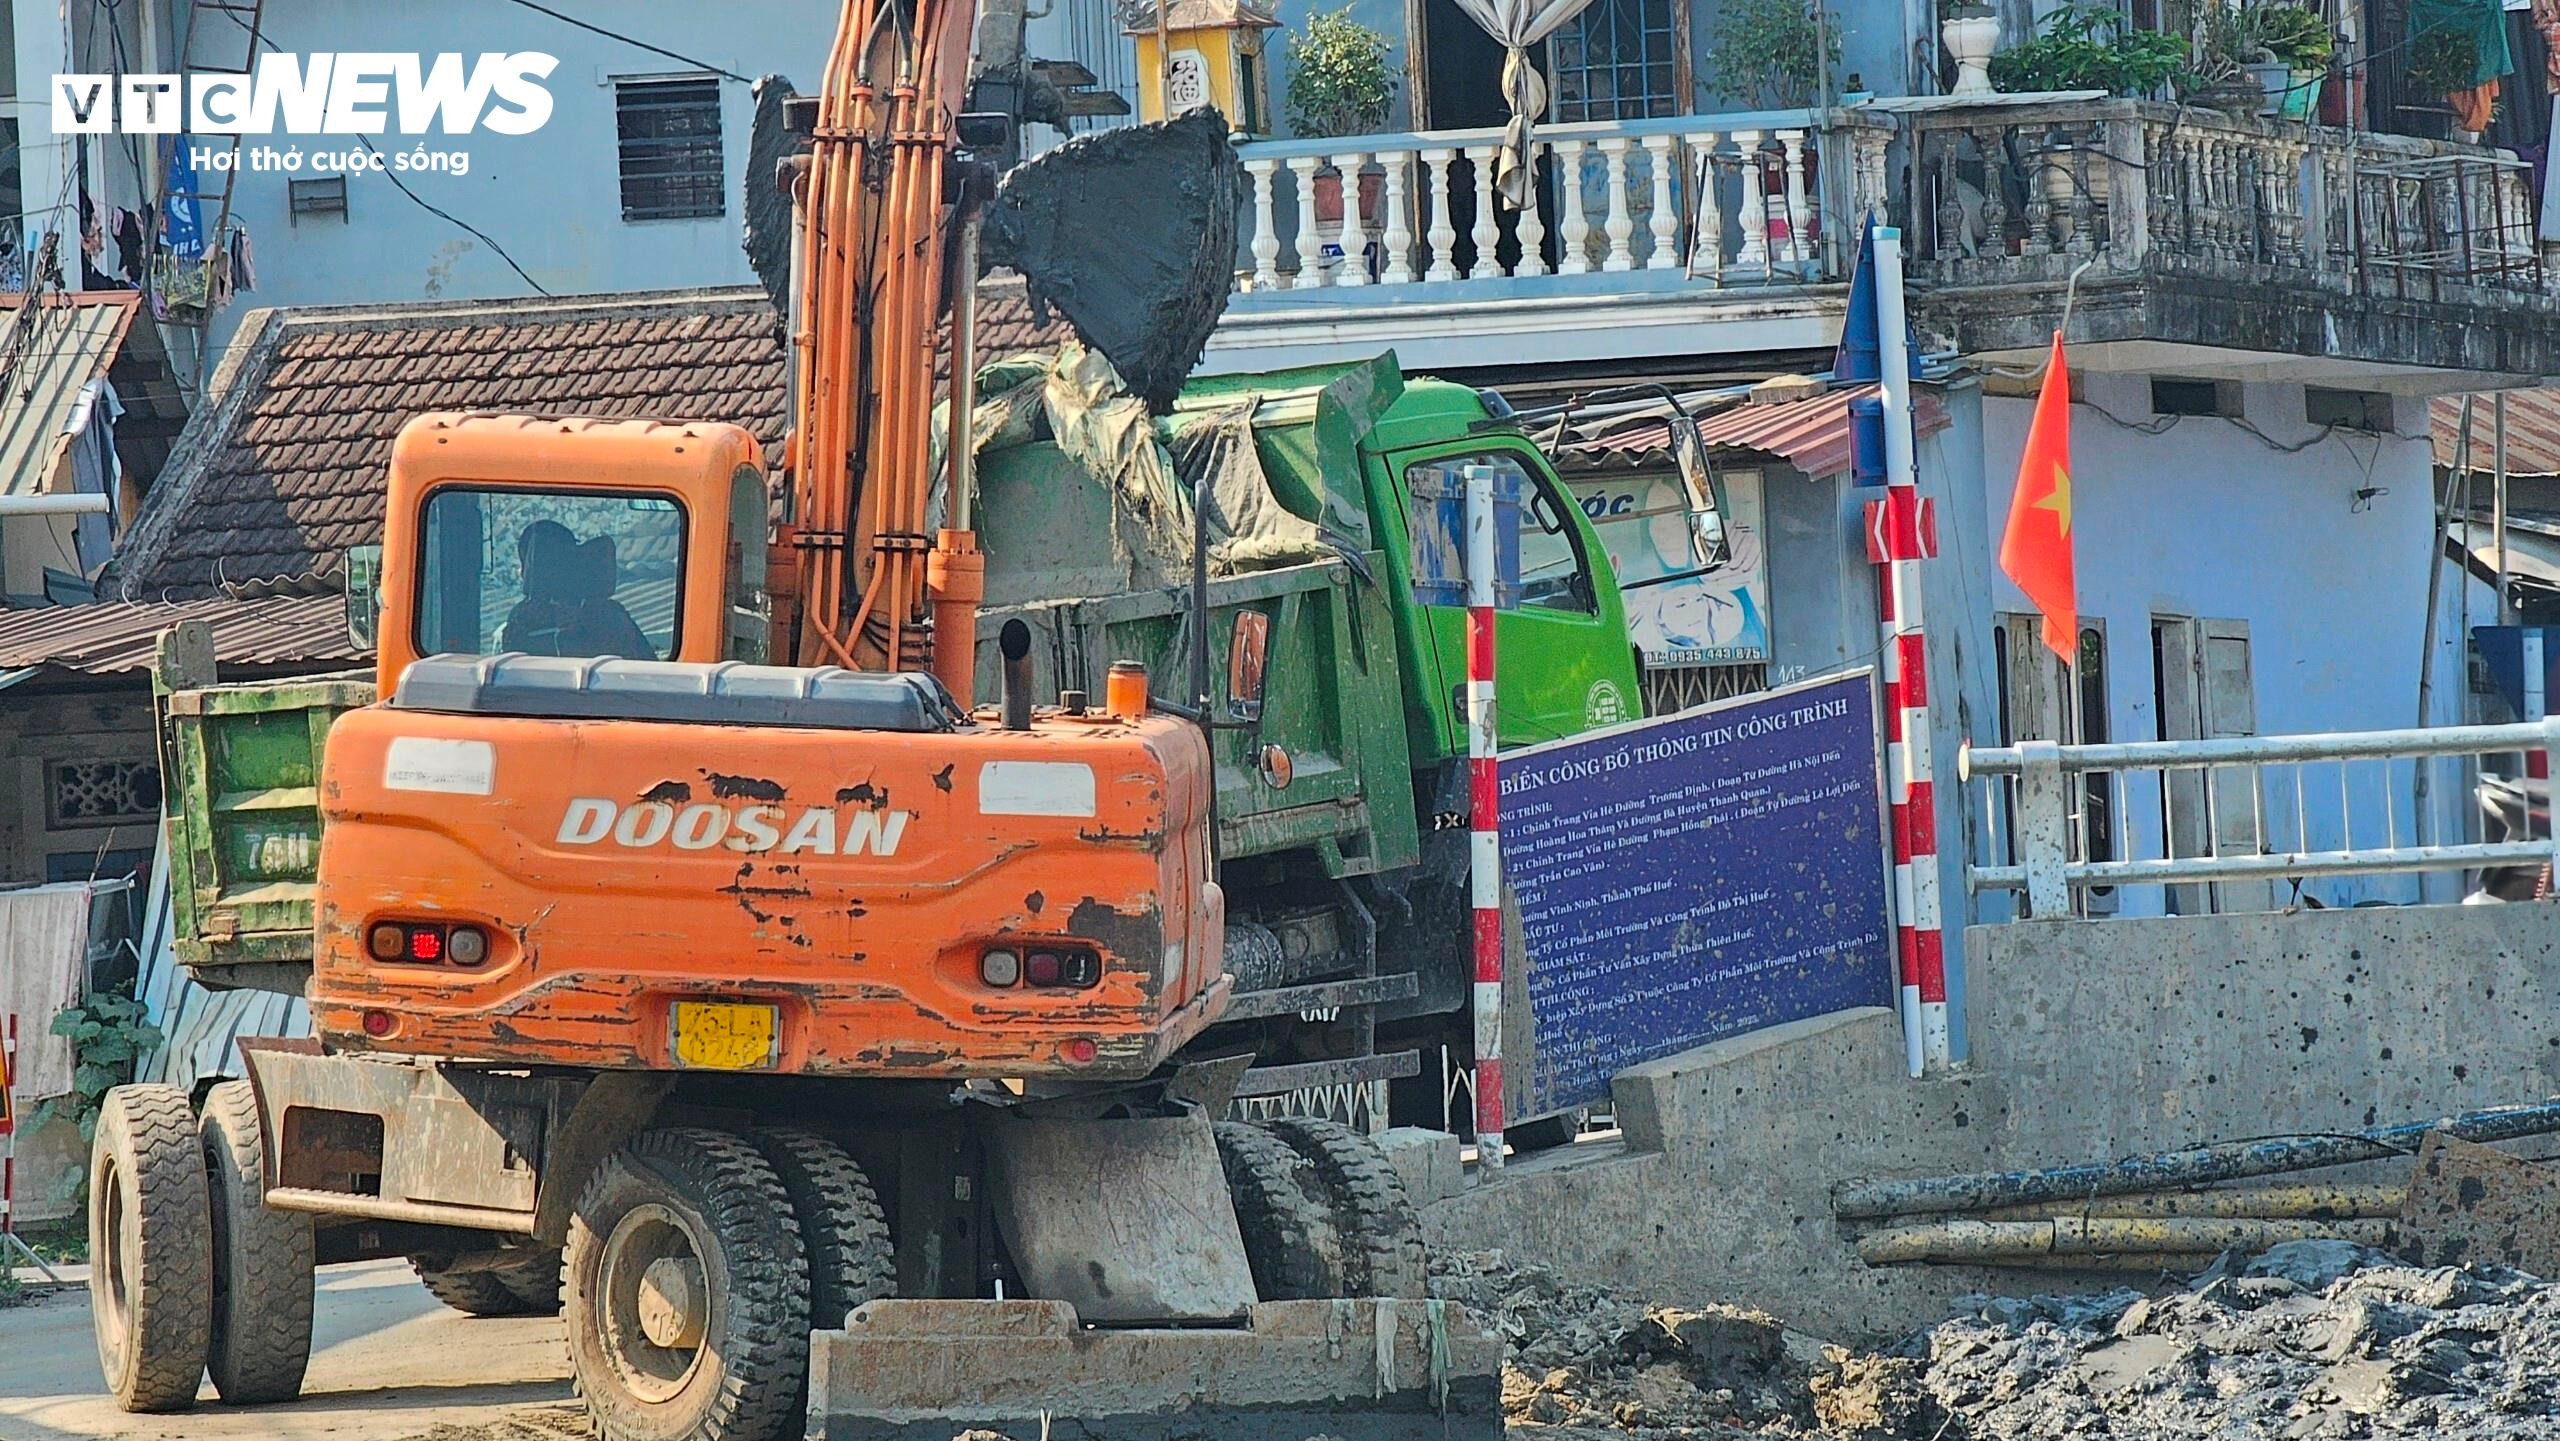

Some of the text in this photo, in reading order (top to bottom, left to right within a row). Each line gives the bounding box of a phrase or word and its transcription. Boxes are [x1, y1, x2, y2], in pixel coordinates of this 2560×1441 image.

[1669, 648, 1702, 663] 0935
[1707, 647, 1732, 661] 443
[1735, 646, 1761, 661] 875
[1500, 698, 1847, 795] BIỂN CÔNG BỐ THÔNG TIN CÔNG TRÌNH
[1552, 814, 1581, 827] Trang
[1789, 759, 1802, 770] Hà
[1804, 754, 1820, 767] Nội
[556, 796, 911, 857] DOOSAN
[1536, 835, 1565, 849] Hoàng
[1616, 818, 1629, 829] Và
[1556, 848, 1583, 862] Trang
[1563, 867, 1581, 877] Cao
